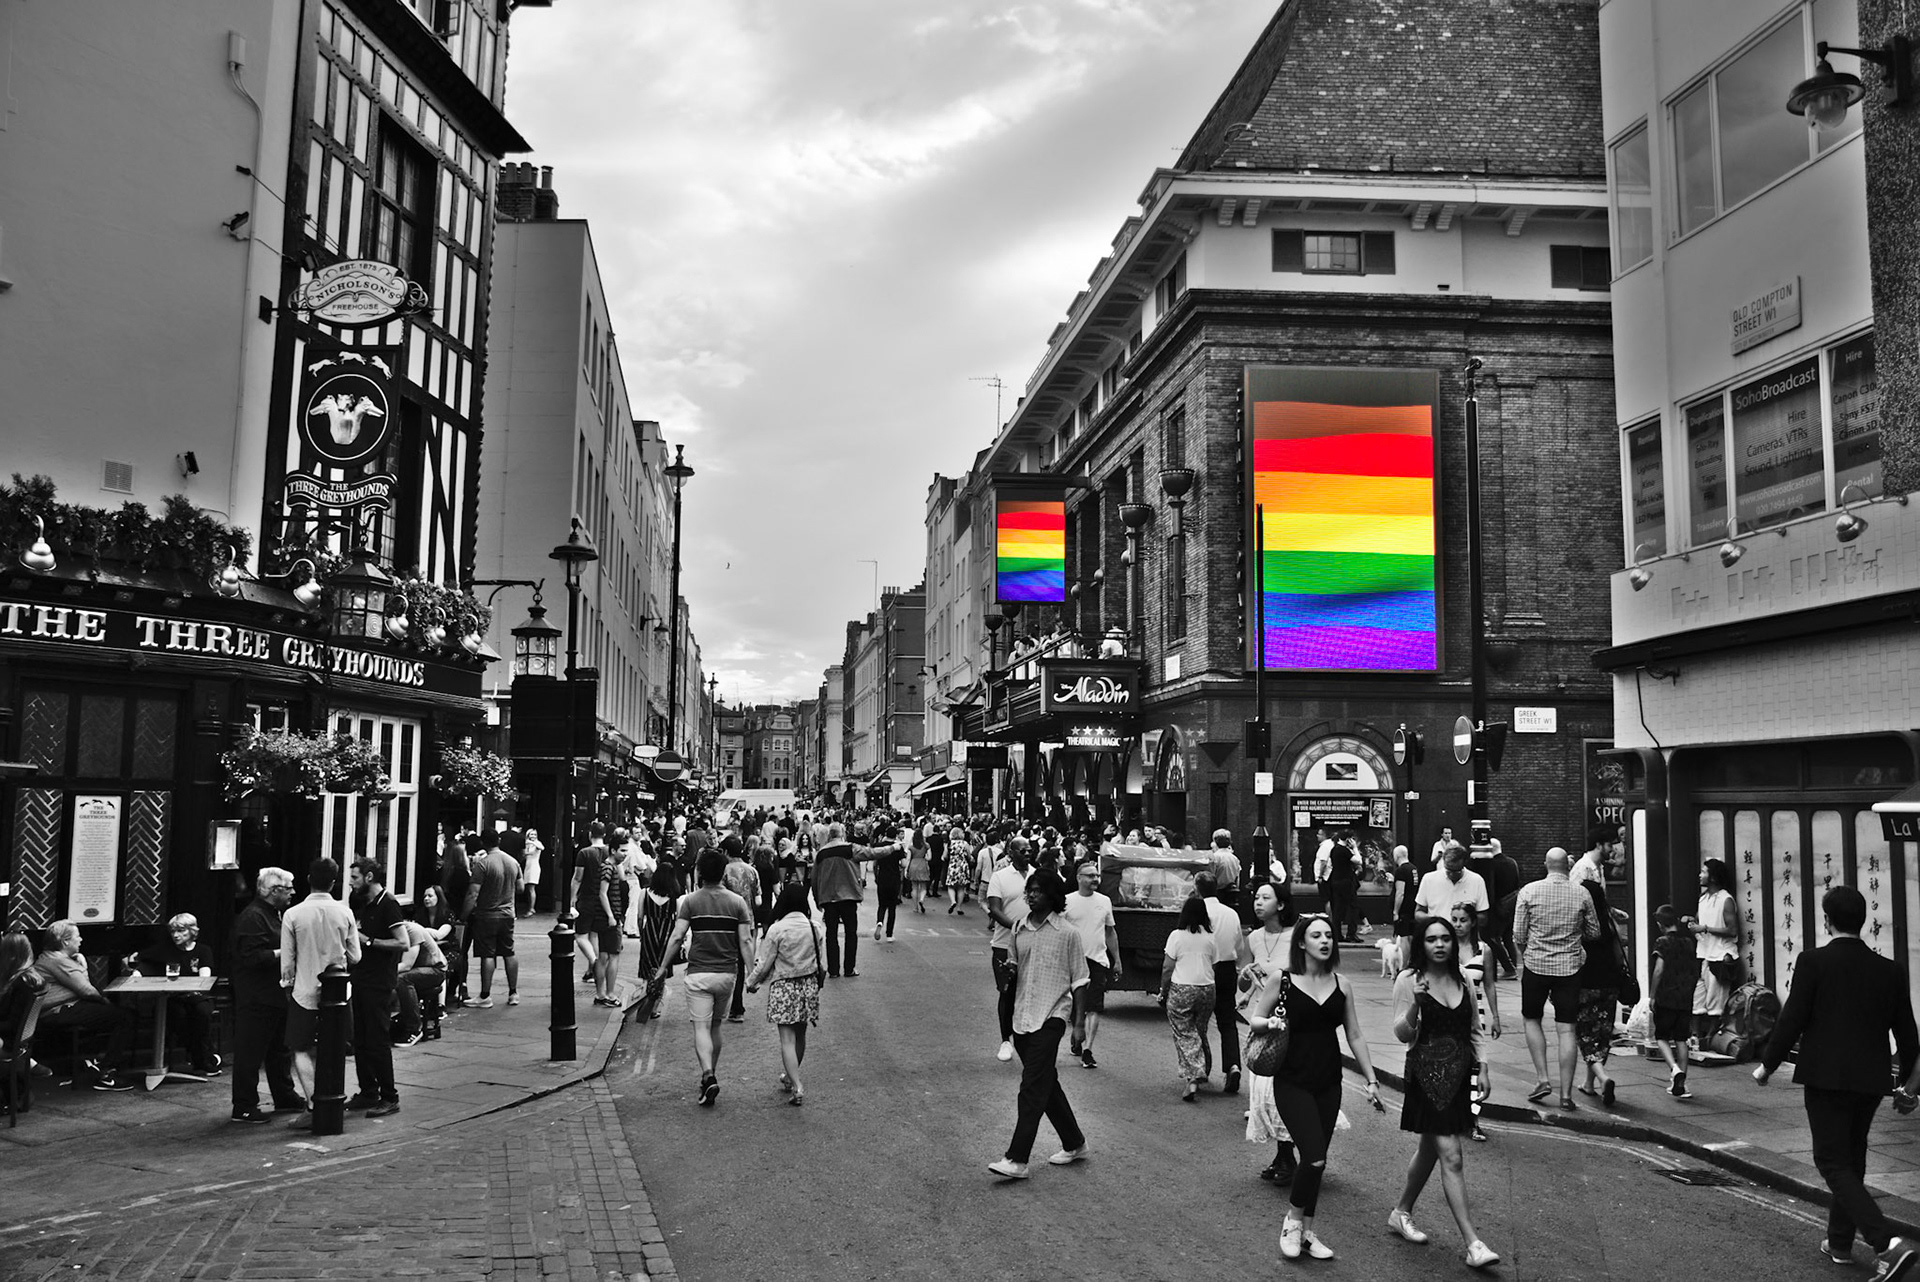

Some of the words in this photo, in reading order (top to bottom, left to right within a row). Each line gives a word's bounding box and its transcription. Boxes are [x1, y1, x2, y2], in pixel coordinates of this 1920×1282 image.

[339, 263, 356, 272] EST.
[315, 280, 396, 301] NICHOLSON'S
[332, 303, 379, 311] FREEHOUSE
[1733, 305, 1748, 323] OLD
[1751, 283, 1792, 314] COMPTON
[1734, 313, 1761, 337] STREET
[1764, 306, 1776, 323] W1
[1845, 350, 1863, 364] Hire
[1735, 366, 1816, 411] SohoBroadcast
[1833, 390, 1858, 405] Canon
[1787, 409, 1807, 424] Hire
[1839, 408, 1858, 422] Sony
[1838, 426, 1864, 440] Canon
[288, 480, 320, 498] THREE
[319, 482, 390, 503] GREYHOUNDS
[0, 602, 107, 642] THE
[136, 616, 270, 660] THREE
[1053, 676, 1130, 703] Aladdin
[1518, 717, 1541, 725] STREET
[1543, 717, 1553, 725] W1
[1066, 736, 1101, 746] THEATRICAL
[1101, 736, 1121, 746] MAGIC
[1890, 818, 1912, 836] La
